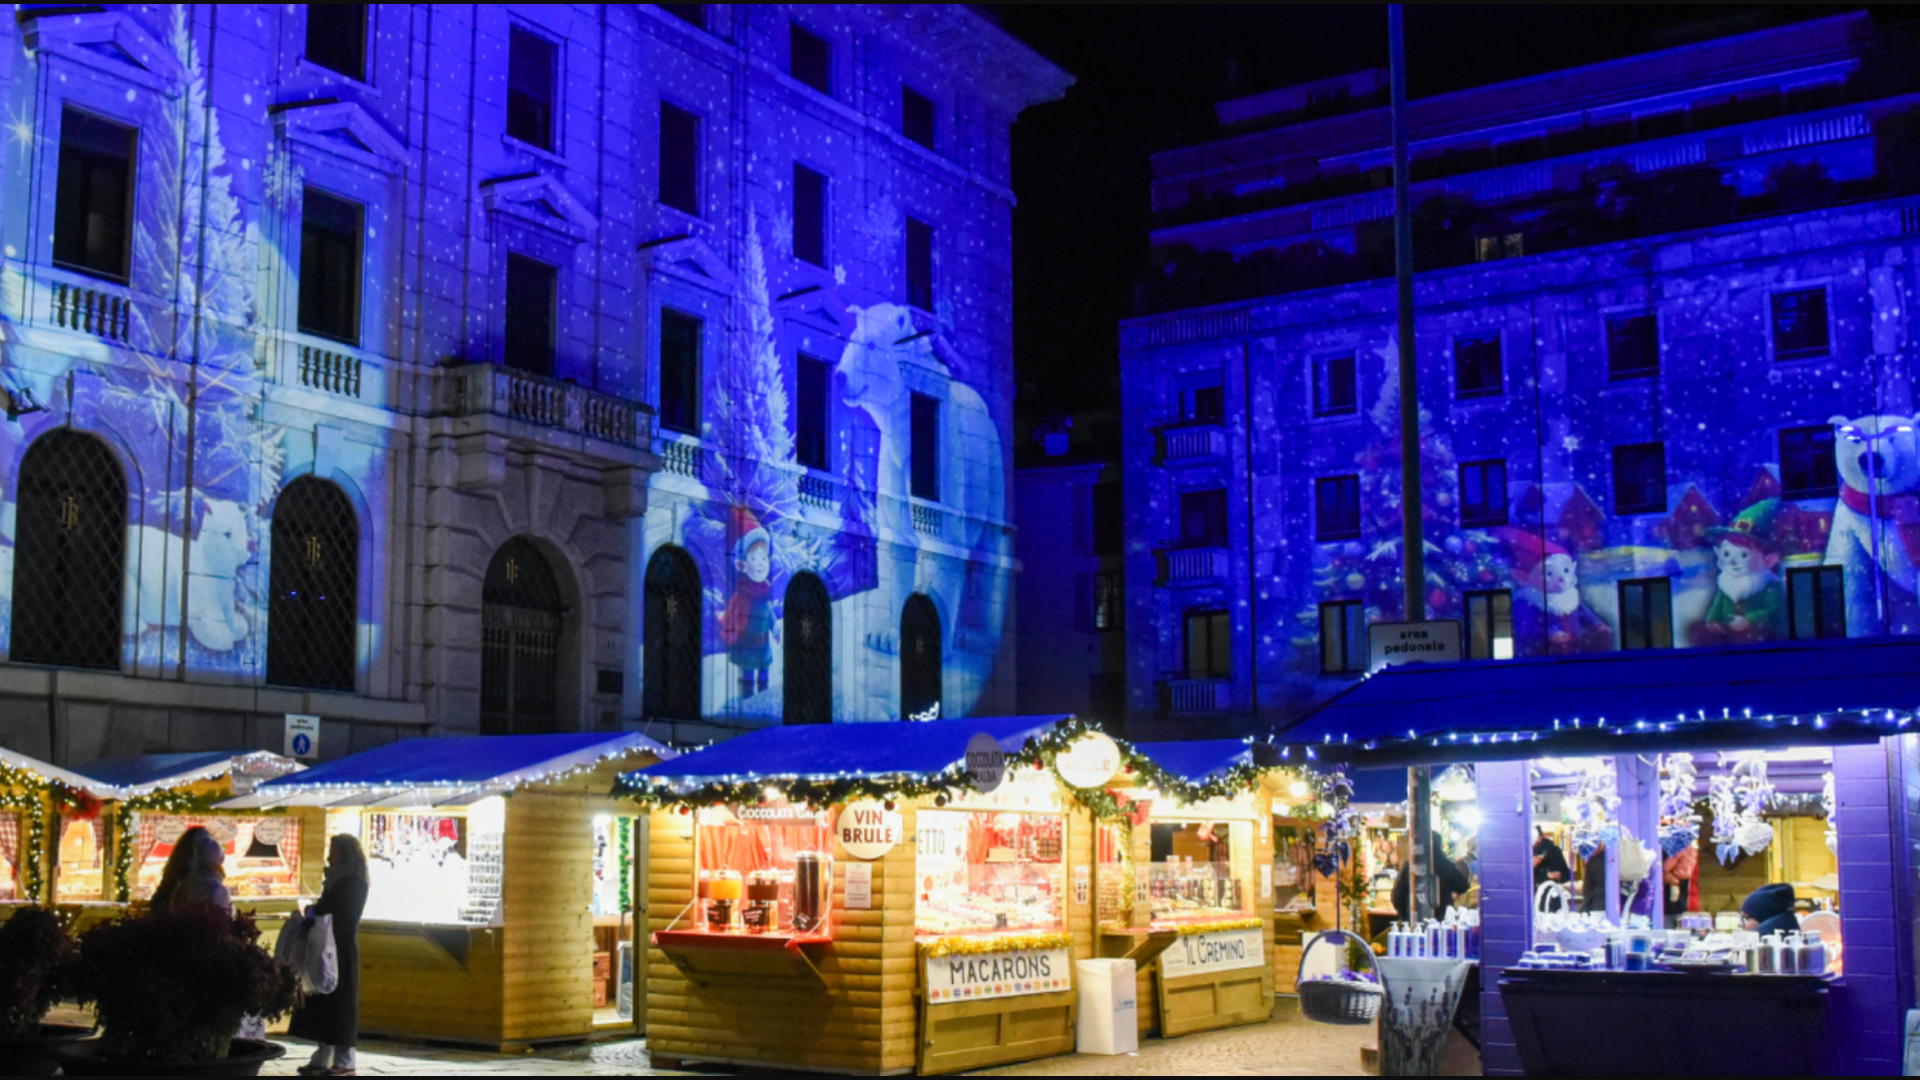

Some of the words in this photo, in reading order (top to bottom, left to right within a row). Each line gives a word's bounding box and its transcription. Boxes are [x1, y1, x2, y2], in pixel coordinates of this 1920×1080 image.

[1400, 630, 1428, 639] area
[1384, 641, 1445, 655] pedonale
[854, 810, 882, 825] VIN
[949, 954, 1051, 985] MACARONS
